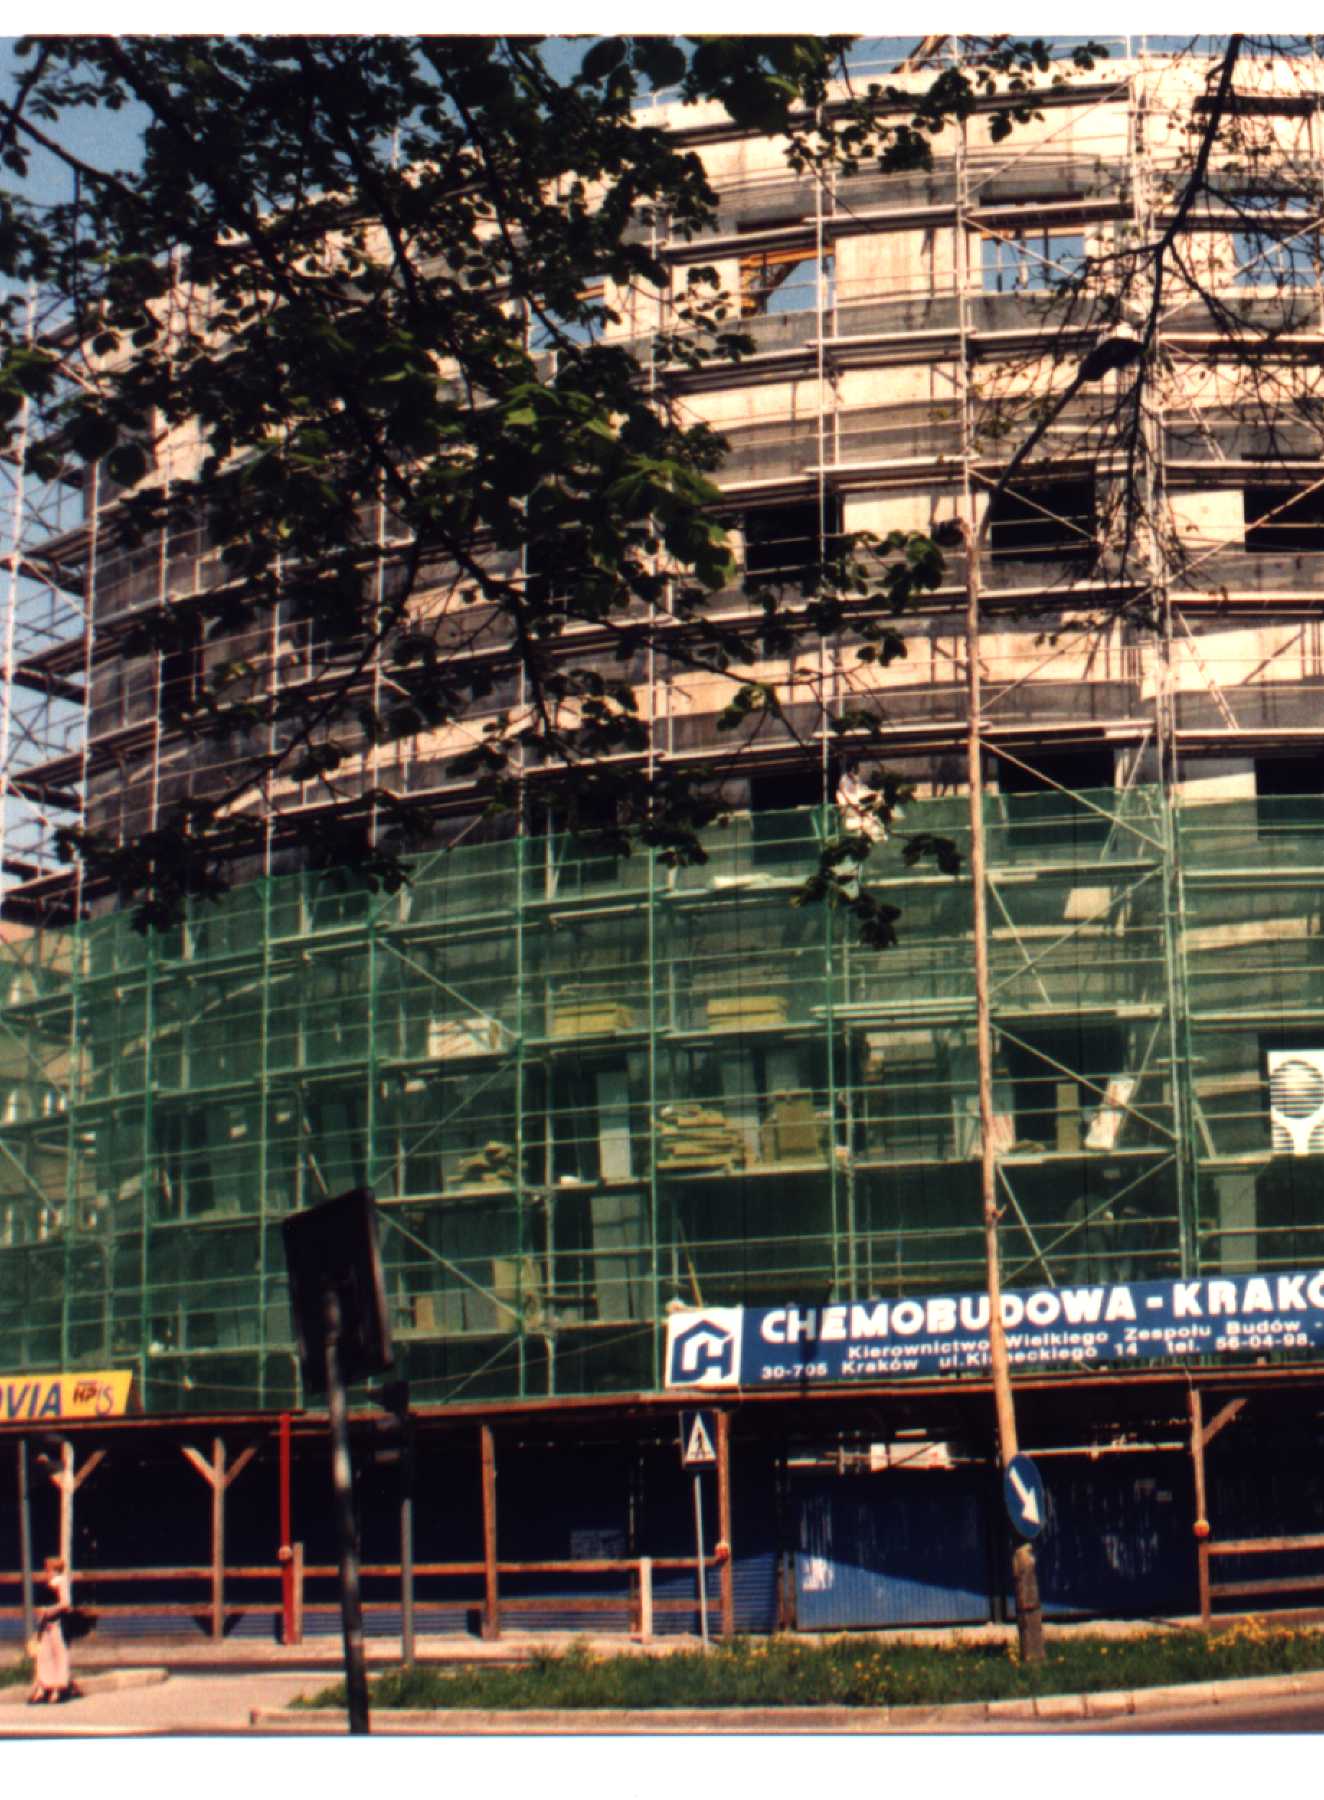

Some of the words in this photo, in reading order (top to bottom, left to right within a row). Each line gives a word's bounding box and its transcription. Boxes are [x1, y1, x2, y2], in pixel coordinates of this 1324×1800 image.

[760, 1287, 1137, 1343] CHEMOBUDOWA
[841, 1356, 919, 1376] Kraków
[1166, 1338, 1201, 1354] tel.
[847, 1339, 990, 1360] Kierownictwo
[1005, 1330, 1109, 1350] Wielkiego
[1225, 1319, 1301, 1335] Budów
[0, 1381, 61, 1418] VIA
